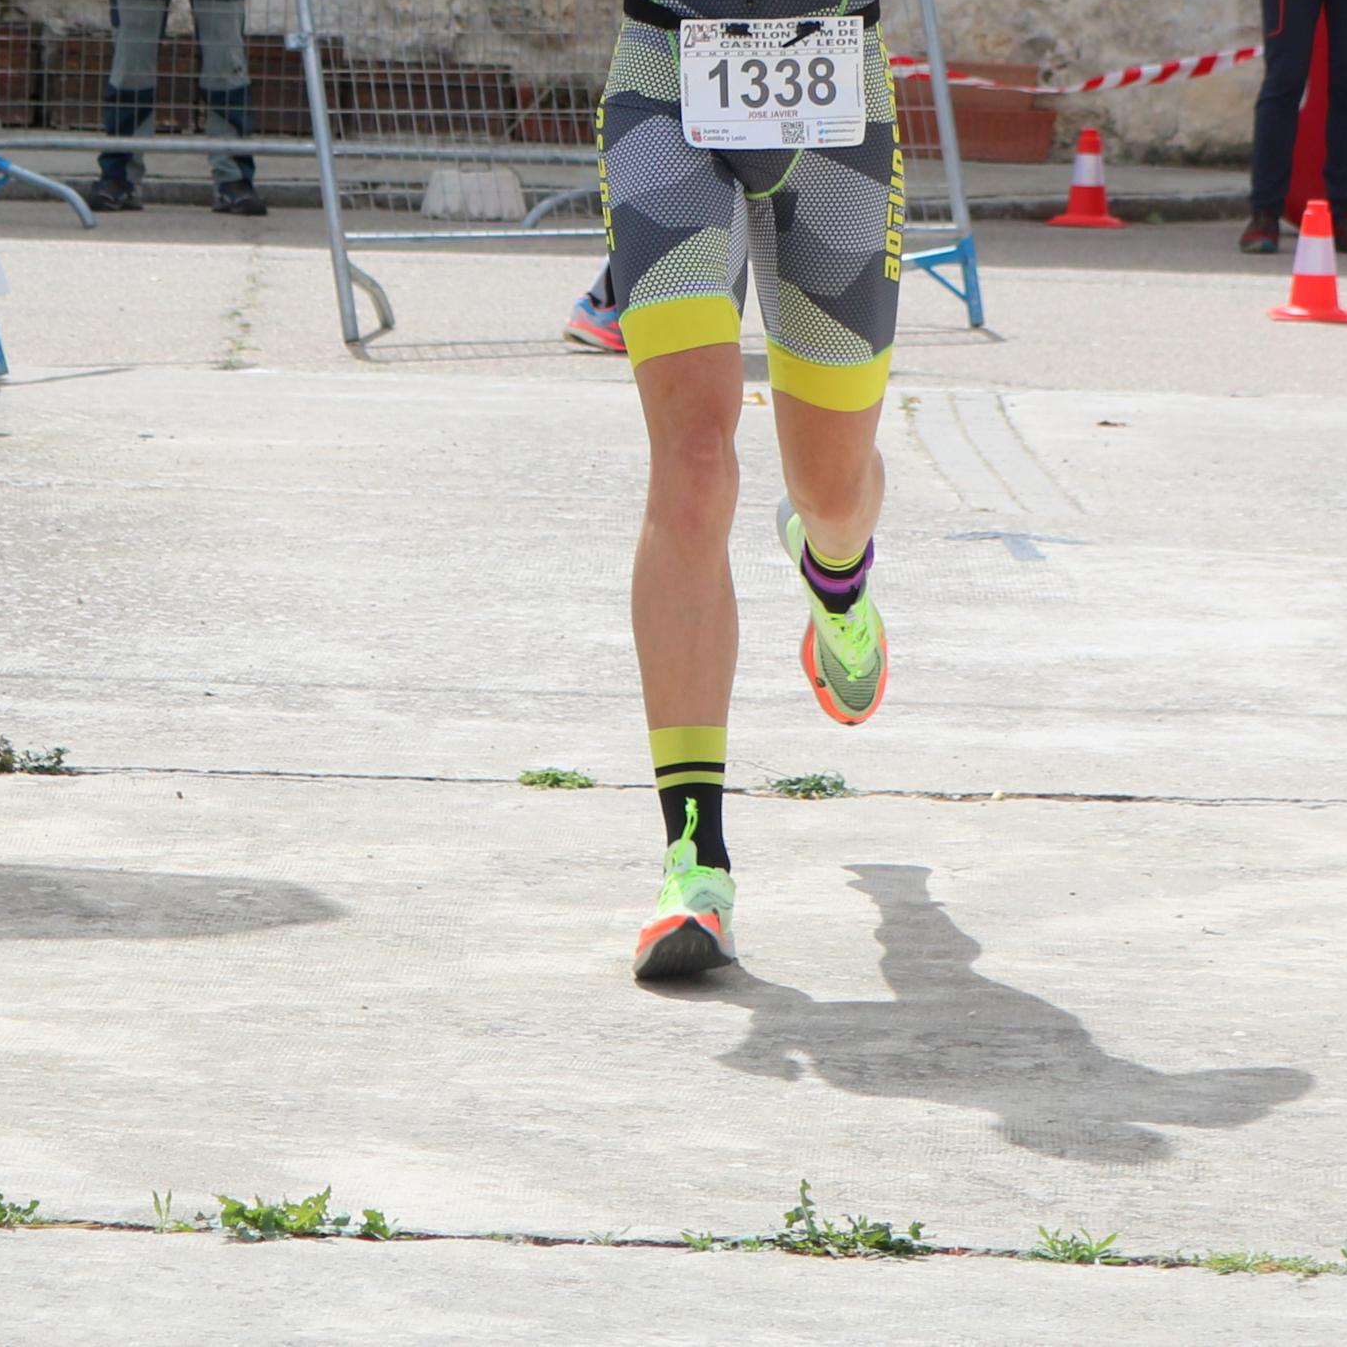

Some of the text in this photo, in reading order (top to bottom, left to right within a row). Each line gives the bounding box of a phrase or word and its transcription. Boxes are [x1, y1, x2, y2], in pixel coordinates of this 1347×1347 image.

[838, 29, 858, 37] DE
[817, 38, 858, 46] LEON
[708, 57, 837, 109] 1338
[748, 109, 798, 120] JOSE JAVIER
